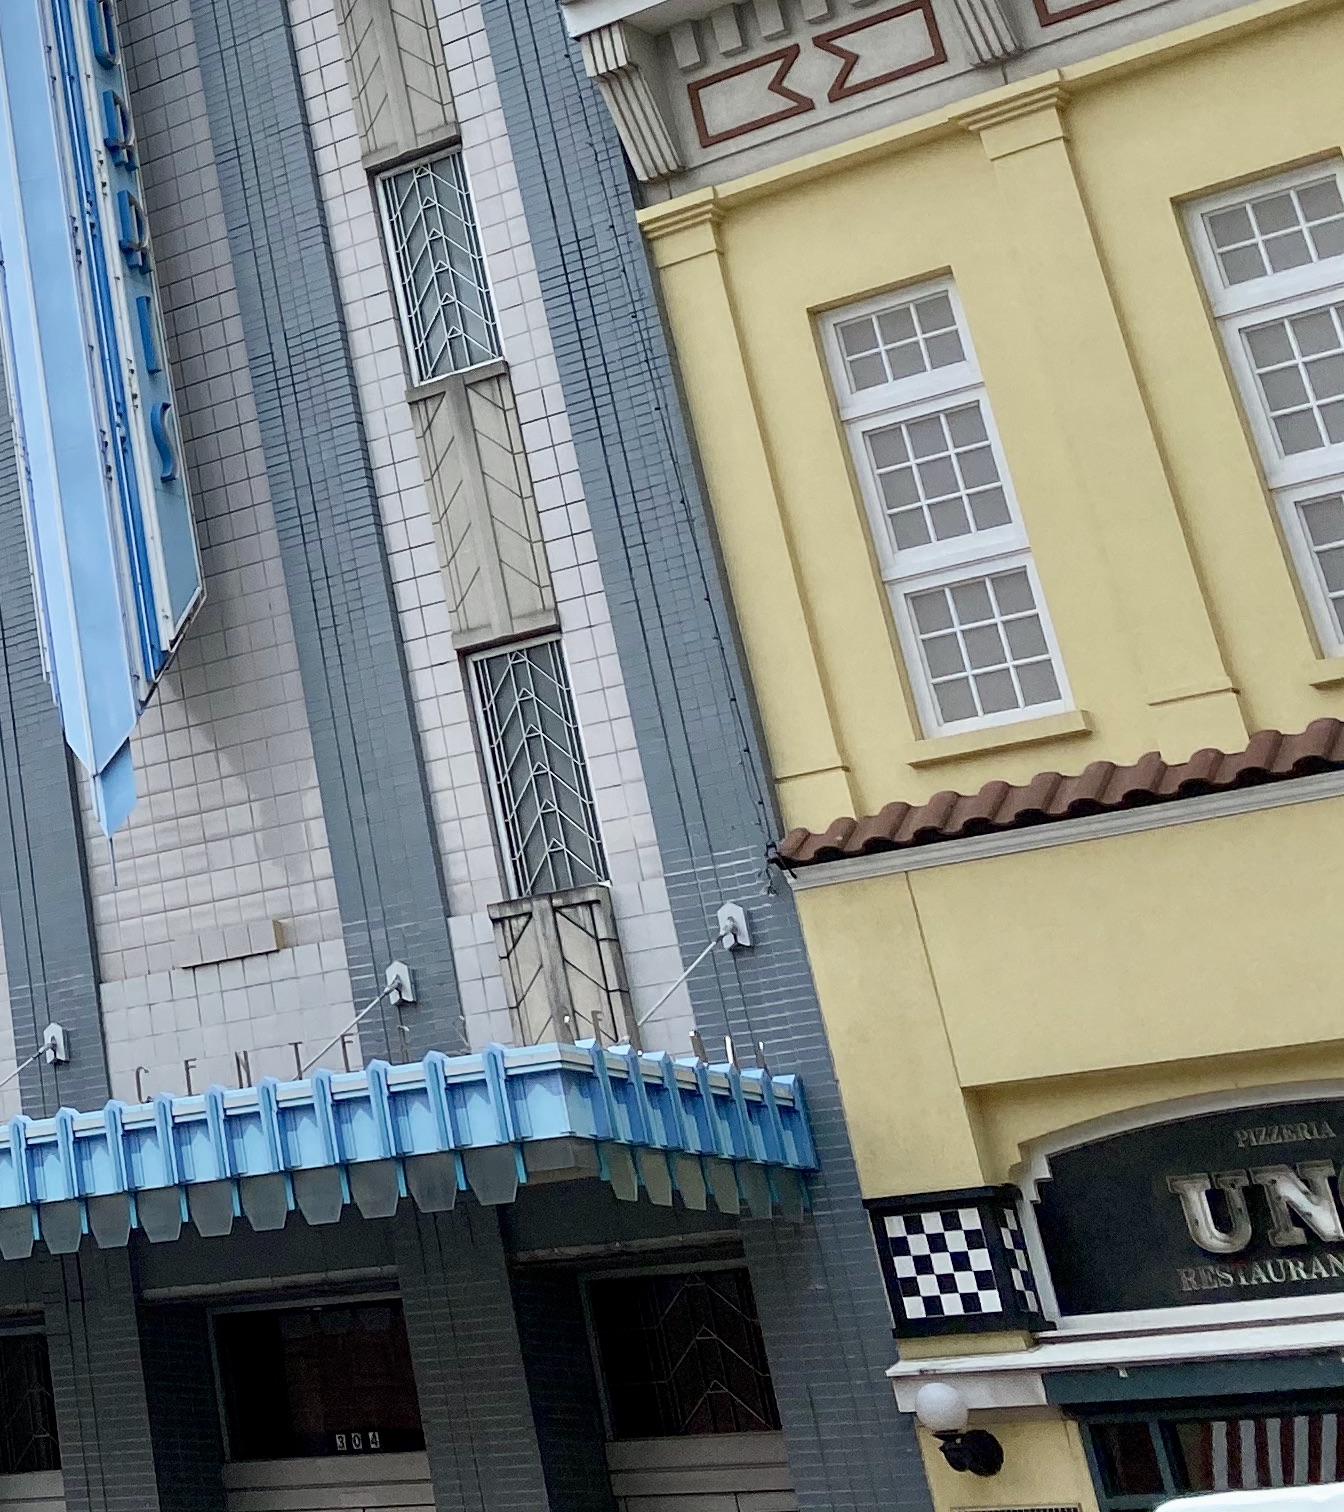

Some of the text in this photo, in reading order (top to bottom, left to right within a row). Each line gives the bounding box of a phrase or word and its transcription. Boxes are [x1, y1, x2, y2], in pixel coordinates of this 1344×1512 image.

[1234, 1120, 1337, 1148] PIZZERIA
[1166, 1159, 1344, 1254] UN
[335, 1432, 380, 1450] 304
